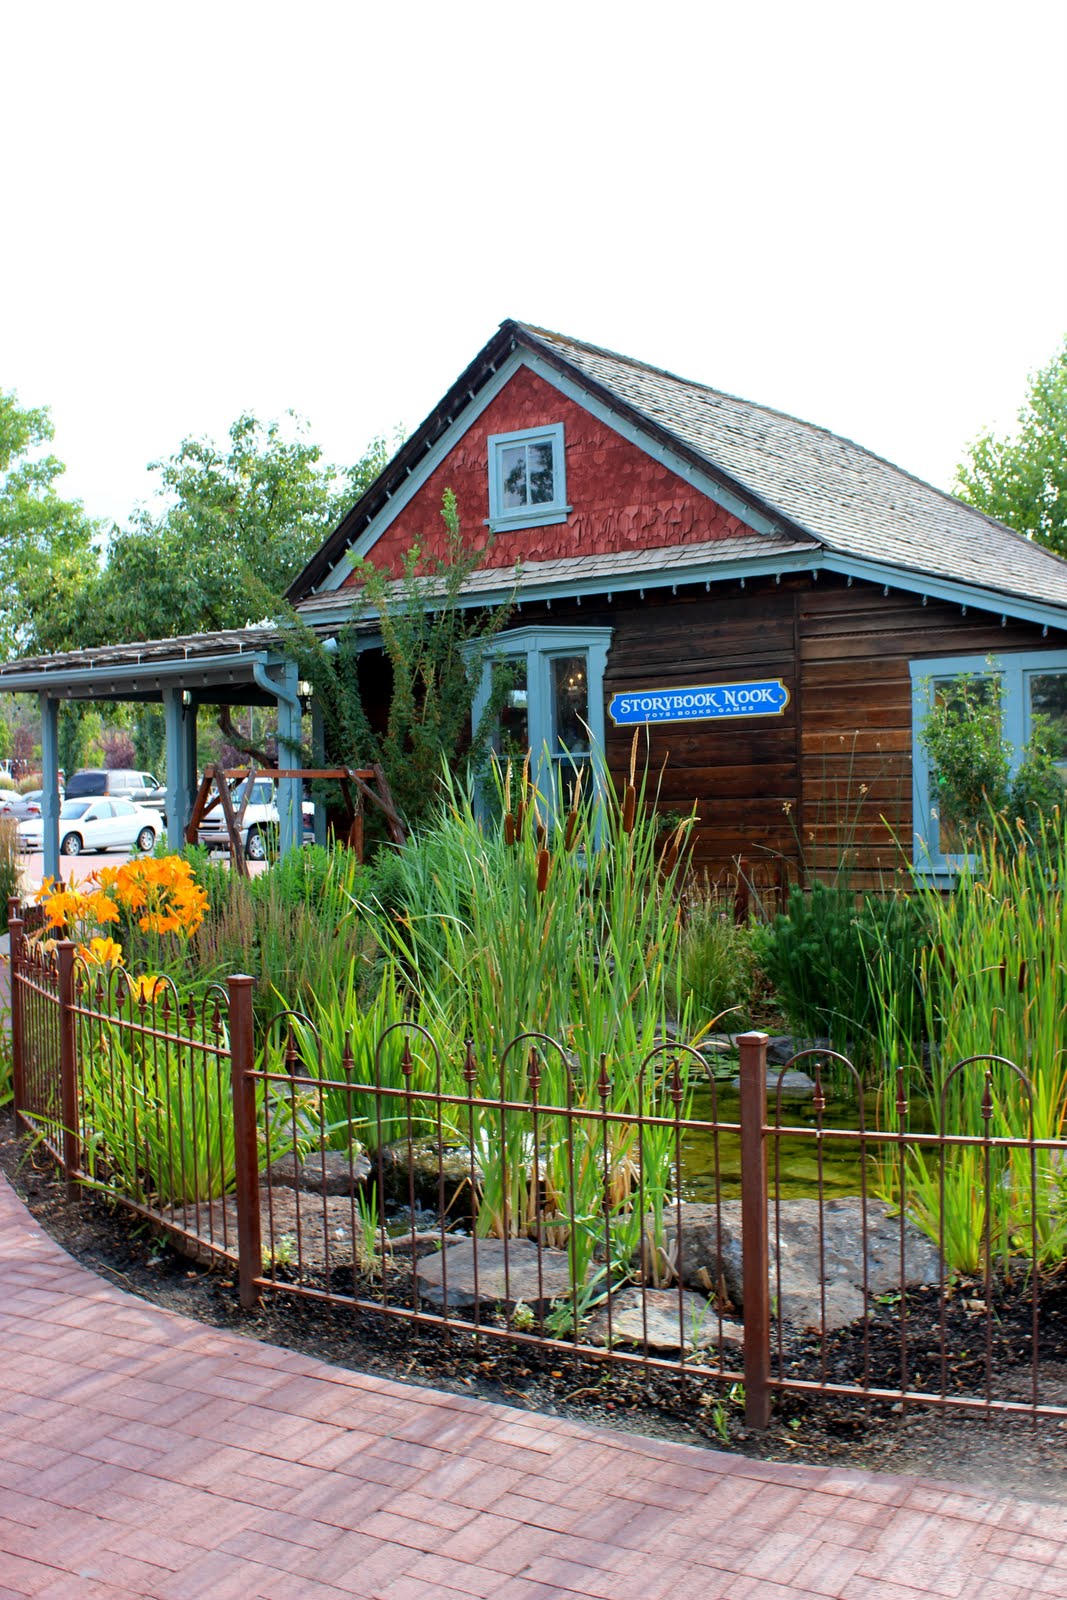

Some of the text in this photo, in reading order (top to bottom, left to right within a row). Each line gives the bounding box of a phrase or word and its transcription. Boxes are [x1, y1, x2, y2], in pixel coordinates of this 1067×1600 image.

[620, 688, 778, 714] STORYBOOK NOOK
[677, 708, 711, 716] BOOKS
[718, 705, 754, 713] GAMES
